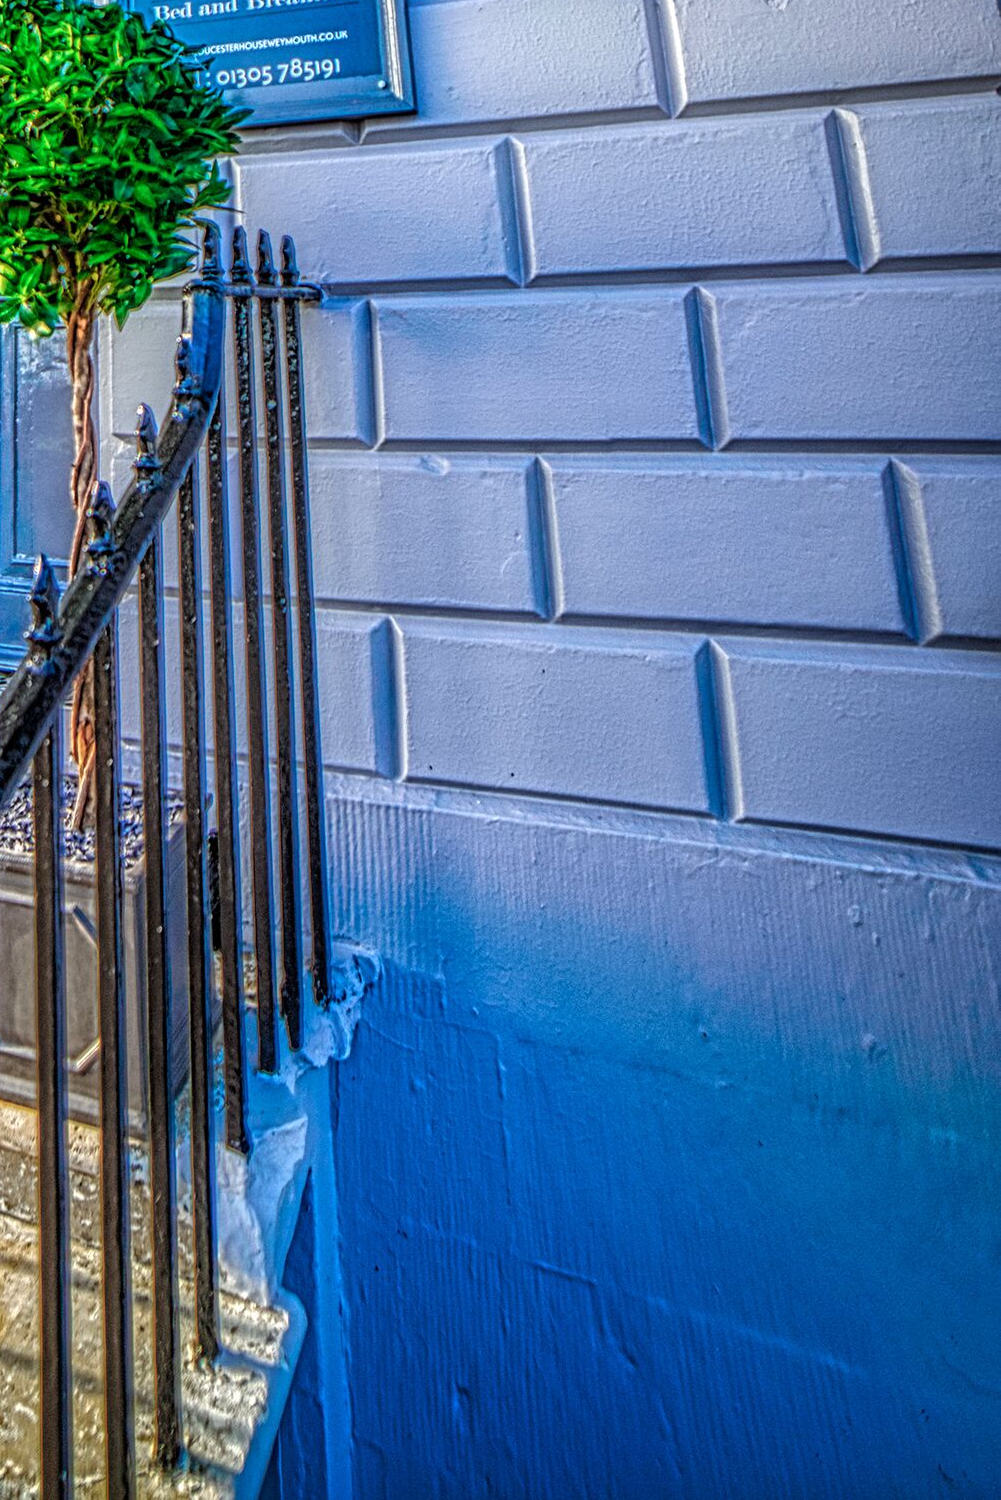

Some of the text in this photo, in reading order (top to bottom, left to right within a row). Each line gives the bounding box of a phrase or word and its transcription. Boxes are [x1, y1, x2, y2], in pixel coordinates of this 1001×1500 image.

[153, 1, 193, 21] Bed
[216, 67, 273, 89] 01305
[276, 57, 341, 84] 785191
